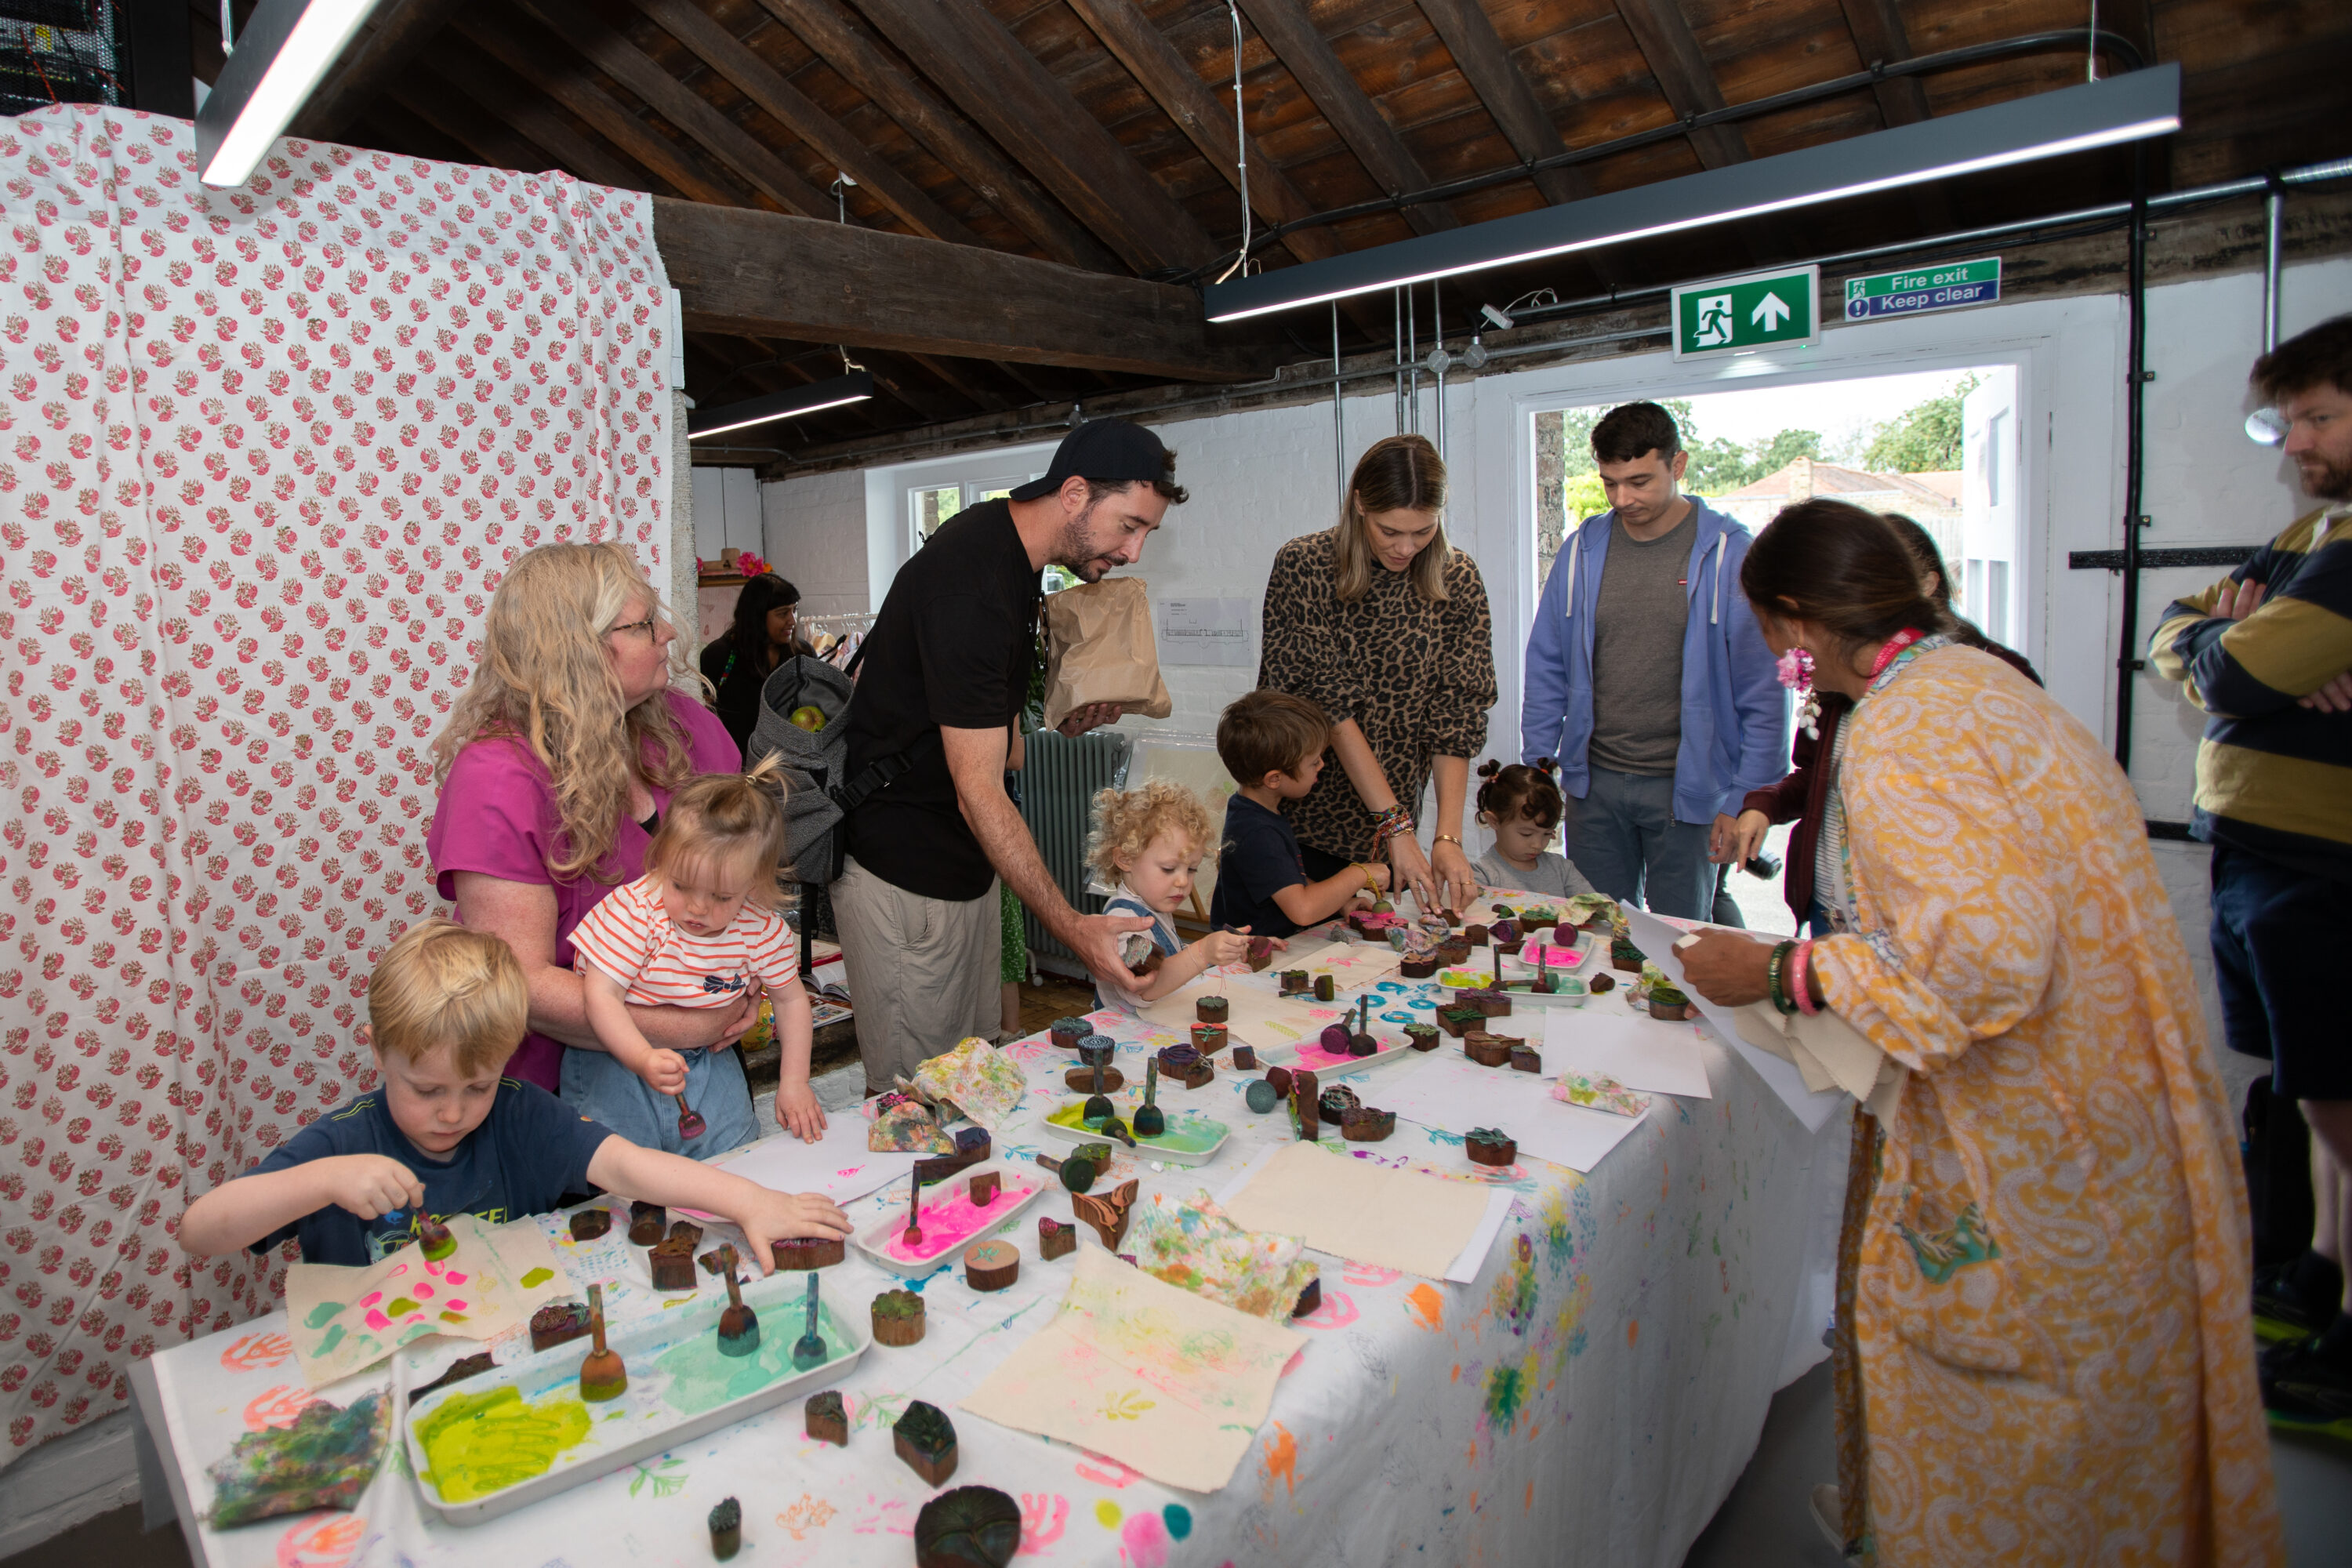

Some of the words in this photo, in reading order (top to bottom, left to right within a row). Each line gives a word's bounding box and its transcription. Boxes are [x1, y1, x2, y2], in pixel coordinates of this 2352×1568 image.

[1893, 276, 1926, 290] Fire
[1933, 268, 1968, 284] exit
[1882, 295, 1929, 310] Keep
[1936, 287, 1983, 303] clear
